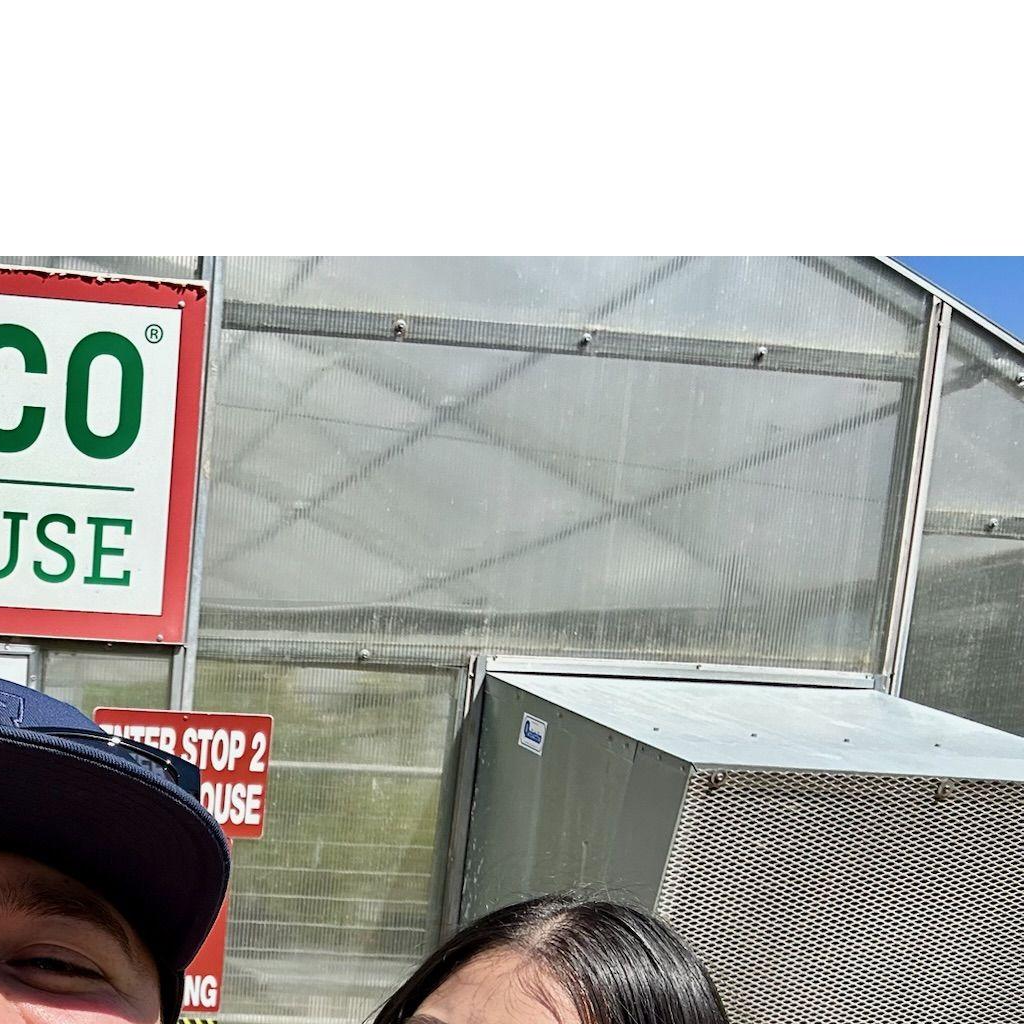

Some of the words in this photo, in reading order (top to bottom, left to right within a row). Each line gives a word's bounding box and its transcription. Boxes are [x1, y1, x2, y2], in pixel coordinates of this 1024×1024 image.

[180, 728, 246, 771] STOP
[249, 731, 267, 772] 2
[200, 782, 263, 825] OUSE
[183, 974, 218, 1008] NG
